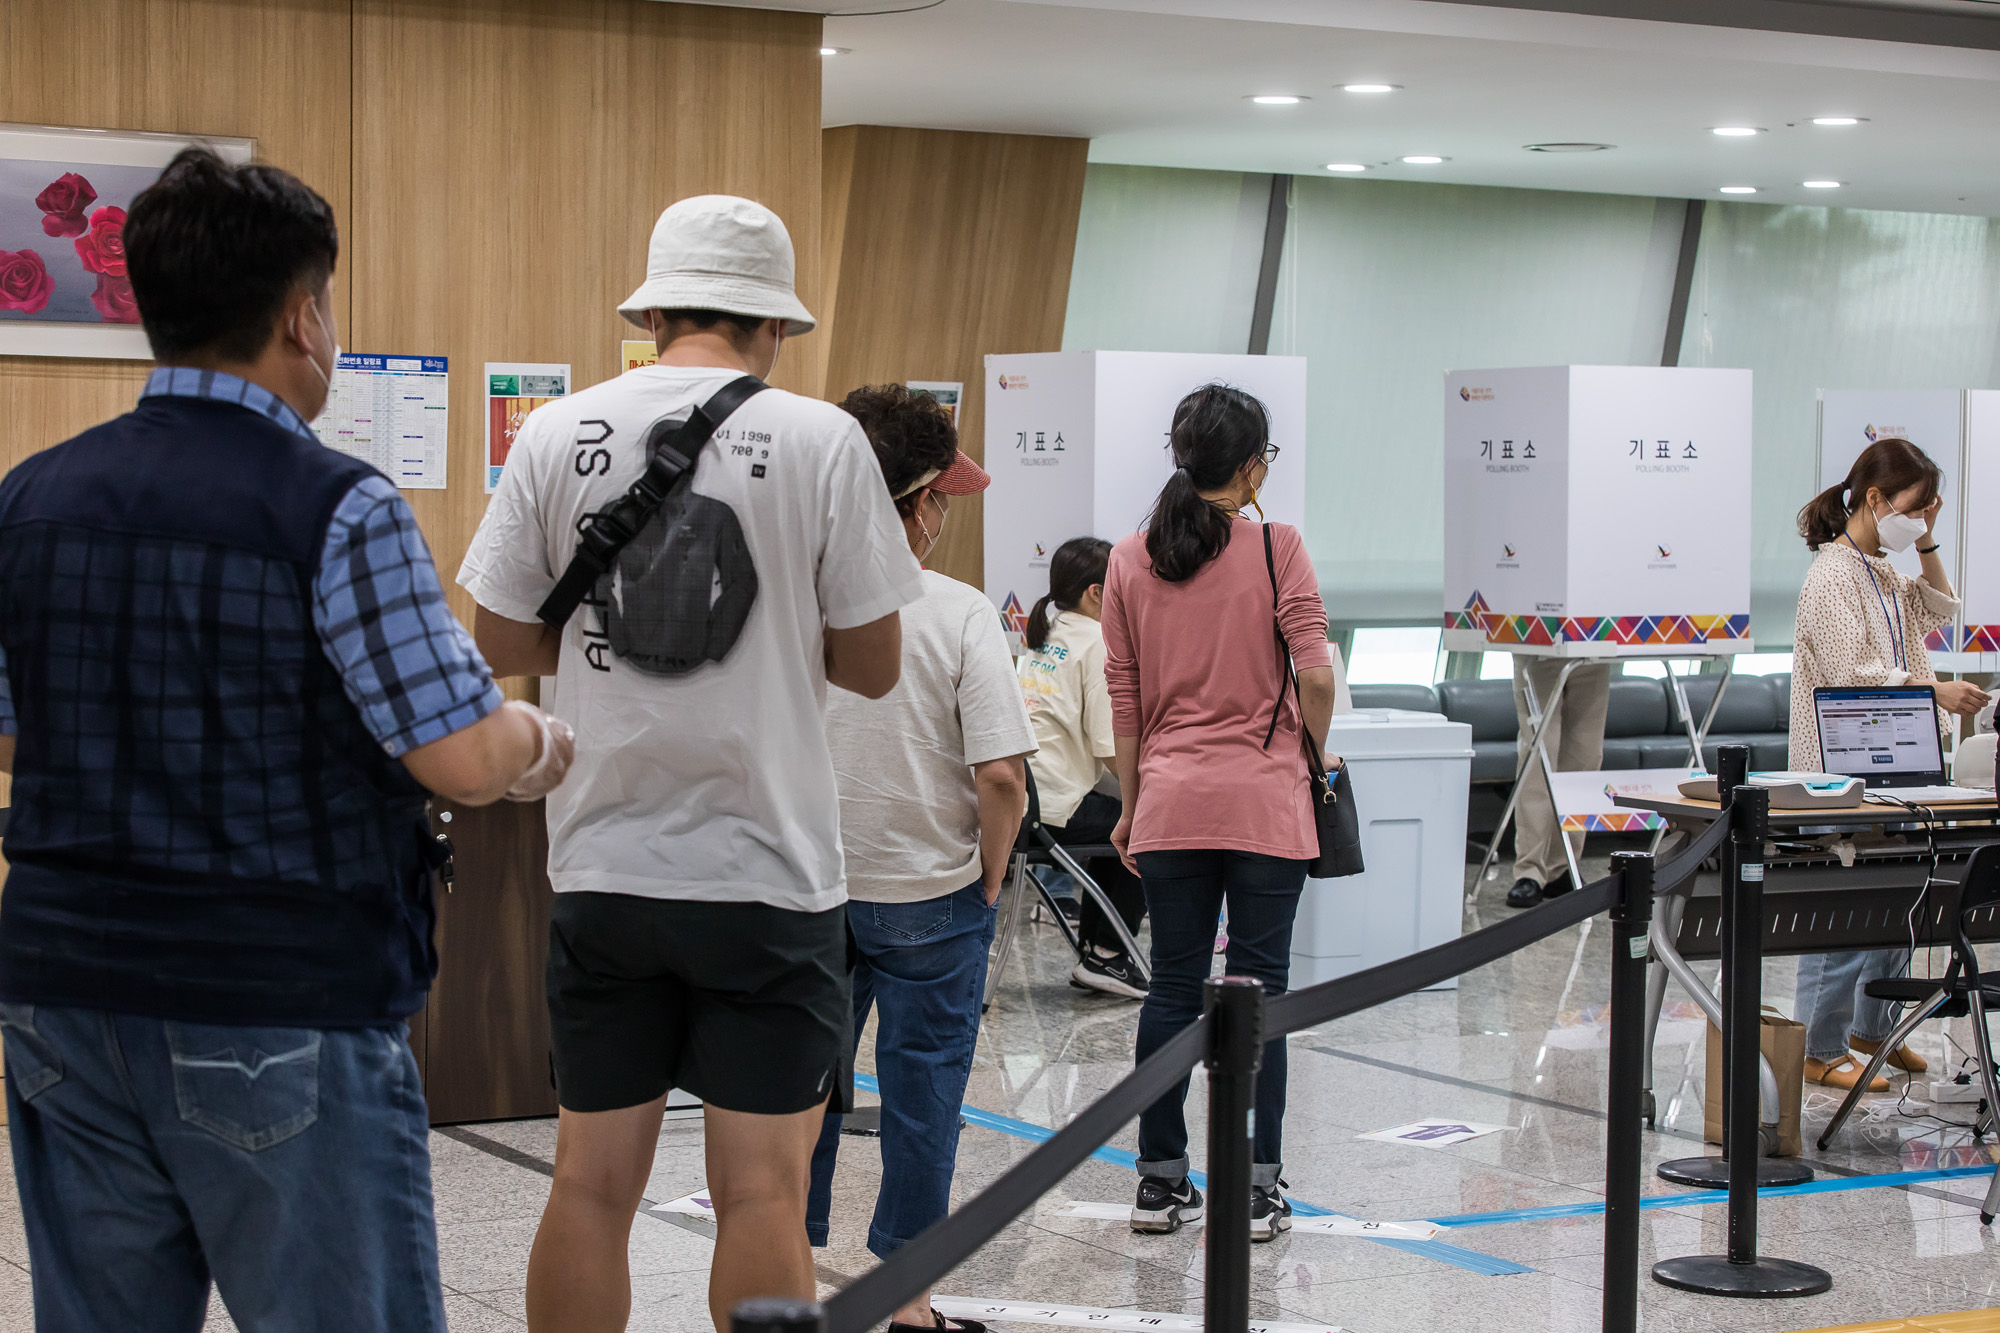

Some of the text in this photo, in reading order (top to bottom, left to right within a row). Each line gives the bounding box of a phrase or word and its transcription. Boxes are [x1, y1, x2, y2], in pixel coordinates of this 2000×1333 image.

[741, 431, 772, 444] 1998
[1016, 431, 1065, 453] 기표소
[574, 419, 614, 477] SV
[730, 445, 753, 457] 700
[1480, 440, 1536, 460] 기표소
[1629, 439, 1698, 460] 기표소
[1635, 464, 1690, 473] POLLING BOOTH
